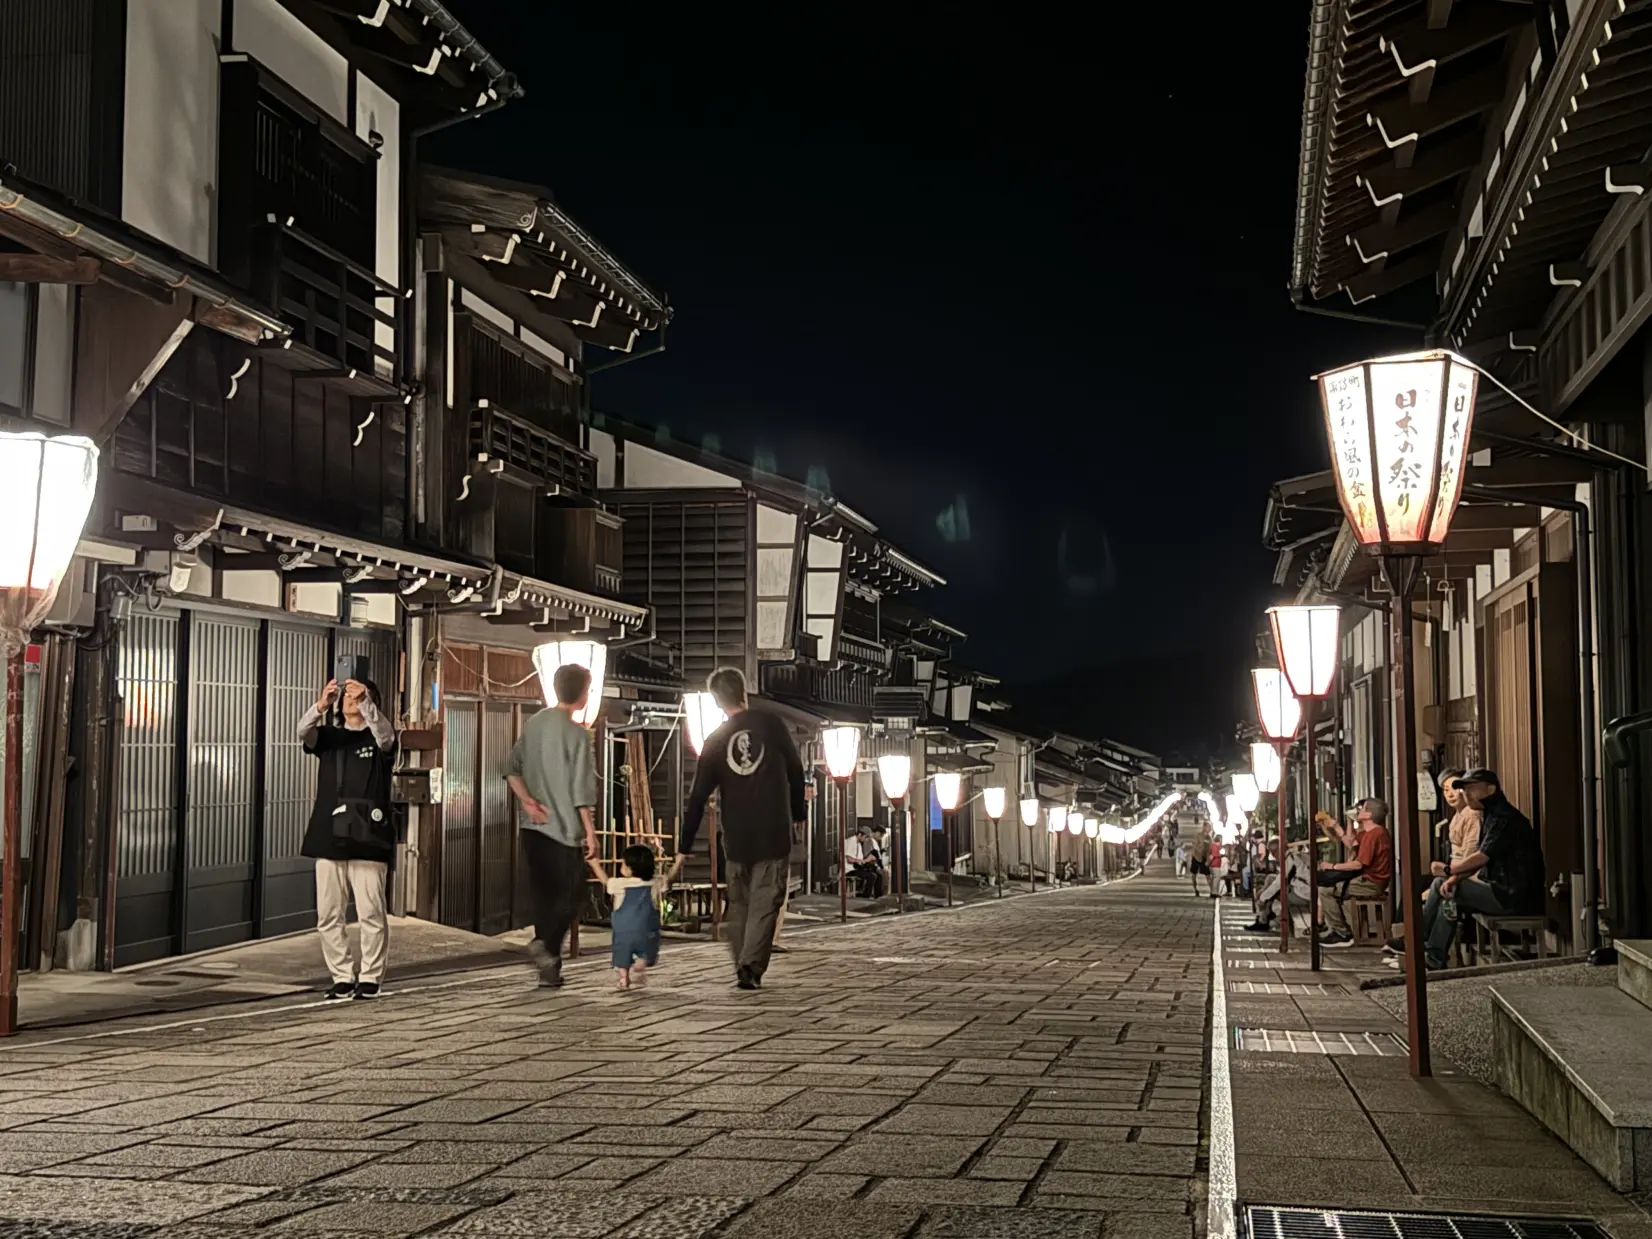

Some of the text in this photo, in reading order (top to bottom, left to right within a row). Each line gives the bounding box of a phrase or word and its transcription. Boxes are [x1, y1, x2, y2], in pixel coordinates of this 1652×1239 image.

[1338, 396, 1366, 499] おわら風の盆
[1388, 388, 1422, 516] 日本の祭り
